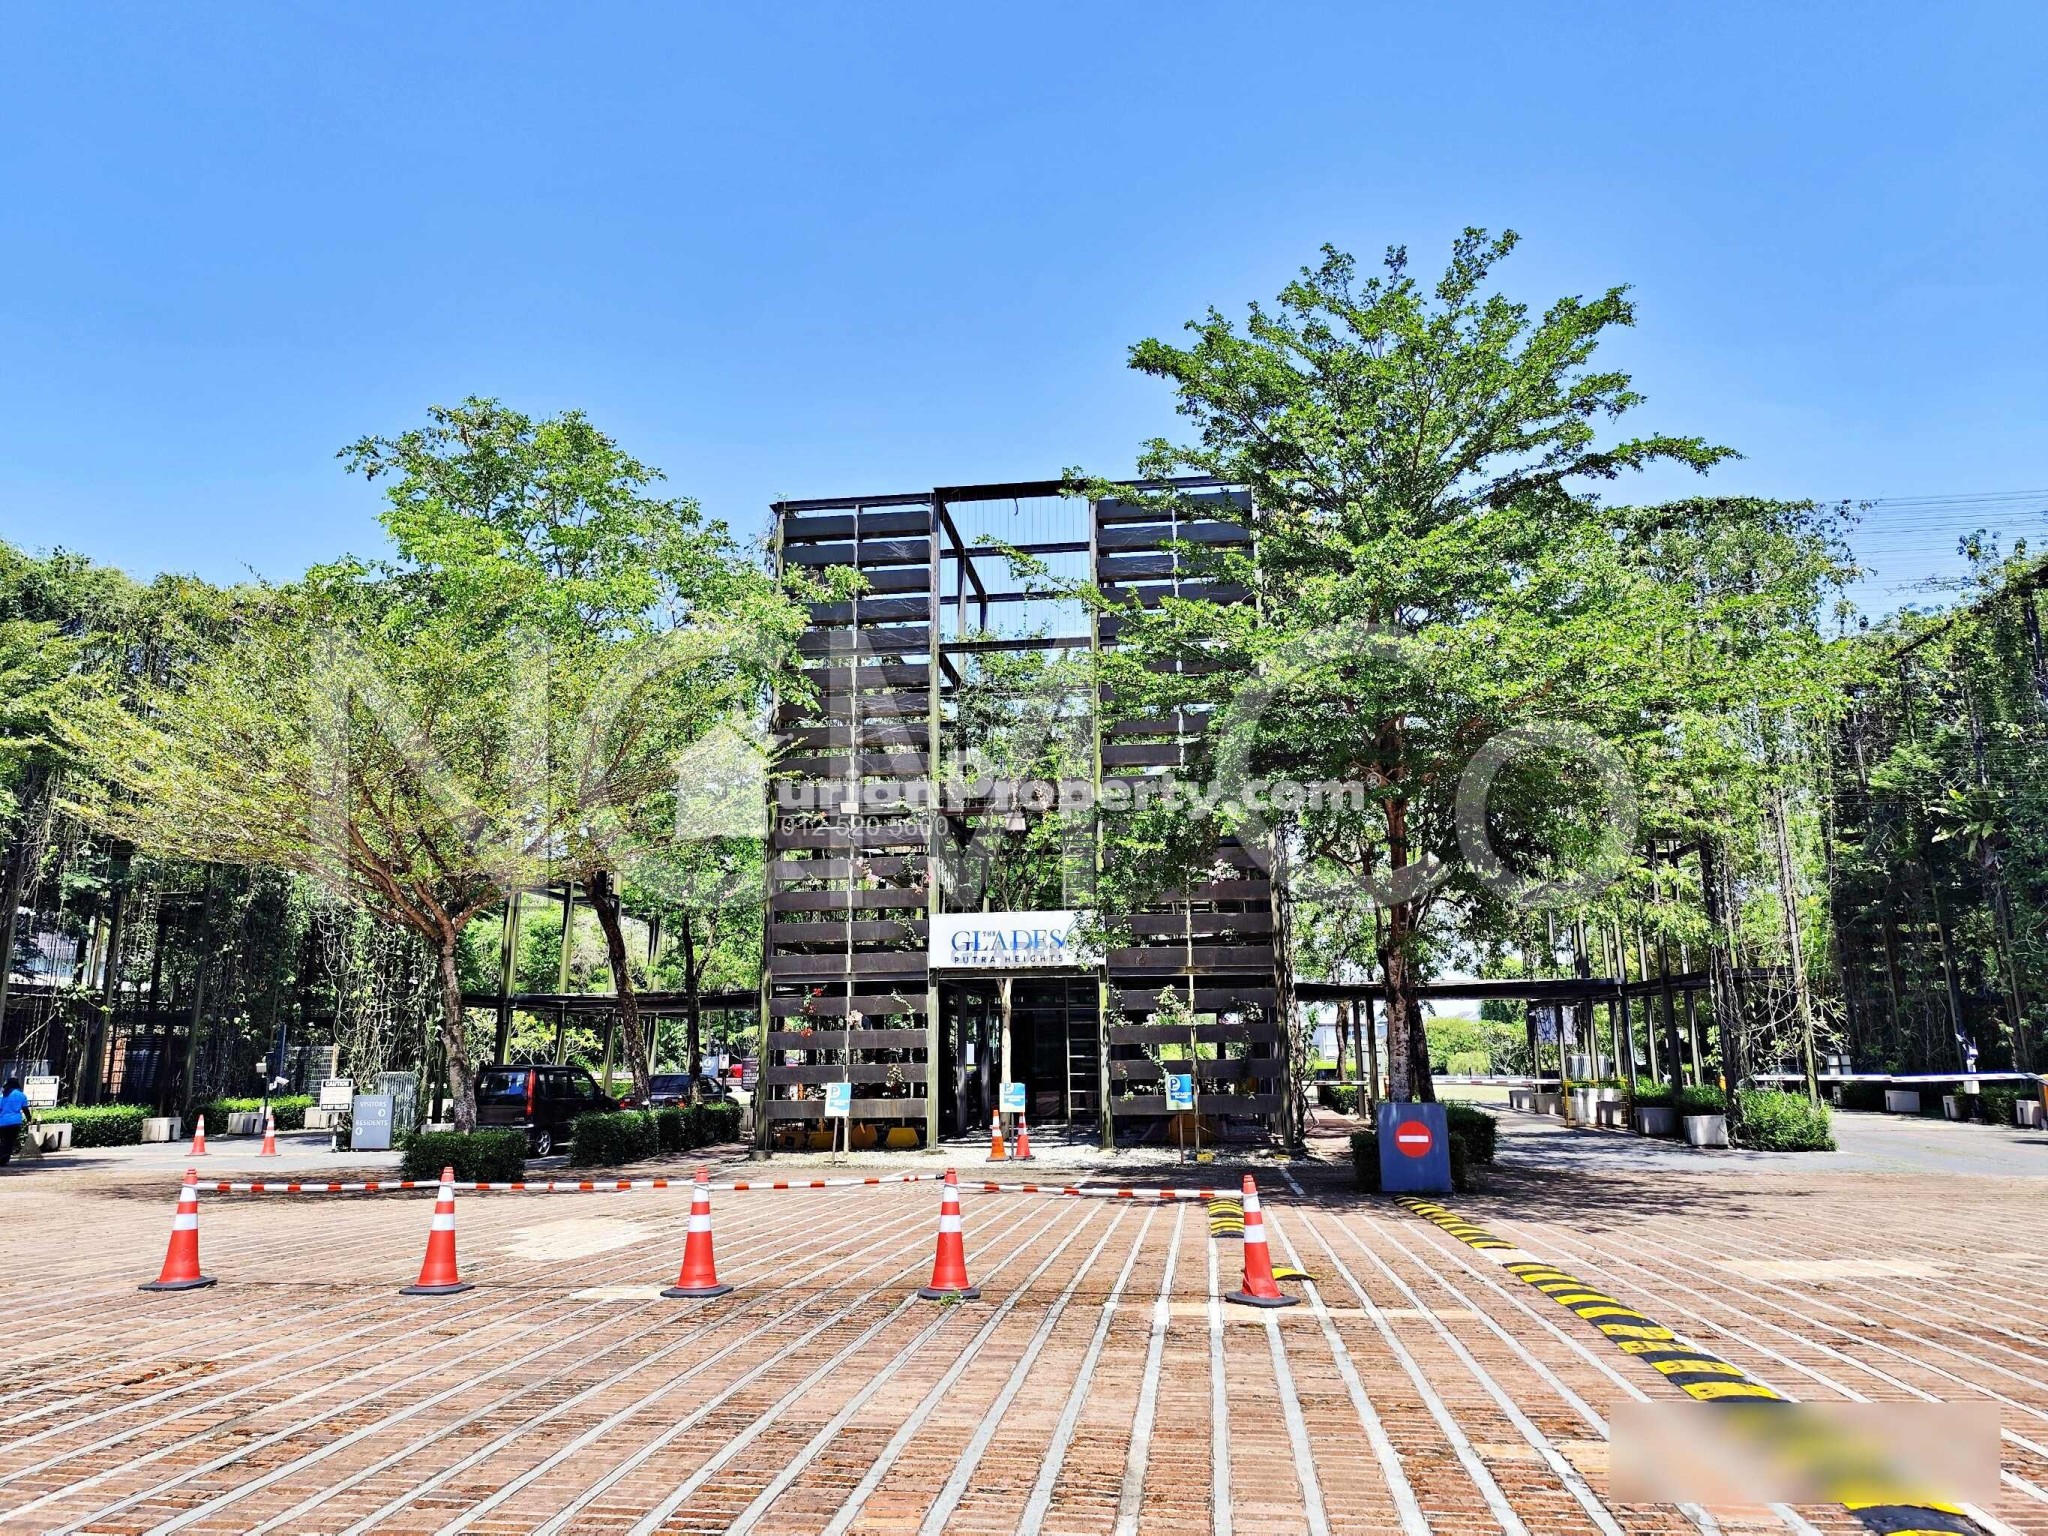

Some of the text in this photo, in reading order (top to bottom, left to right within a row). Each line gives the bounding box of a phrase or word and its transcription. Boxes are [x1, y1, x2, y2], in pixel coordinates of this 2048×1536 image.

[951, 929, 1063, 951] GLADES
[954, 955, 1064, 964] PUTRA HEIGHTS
